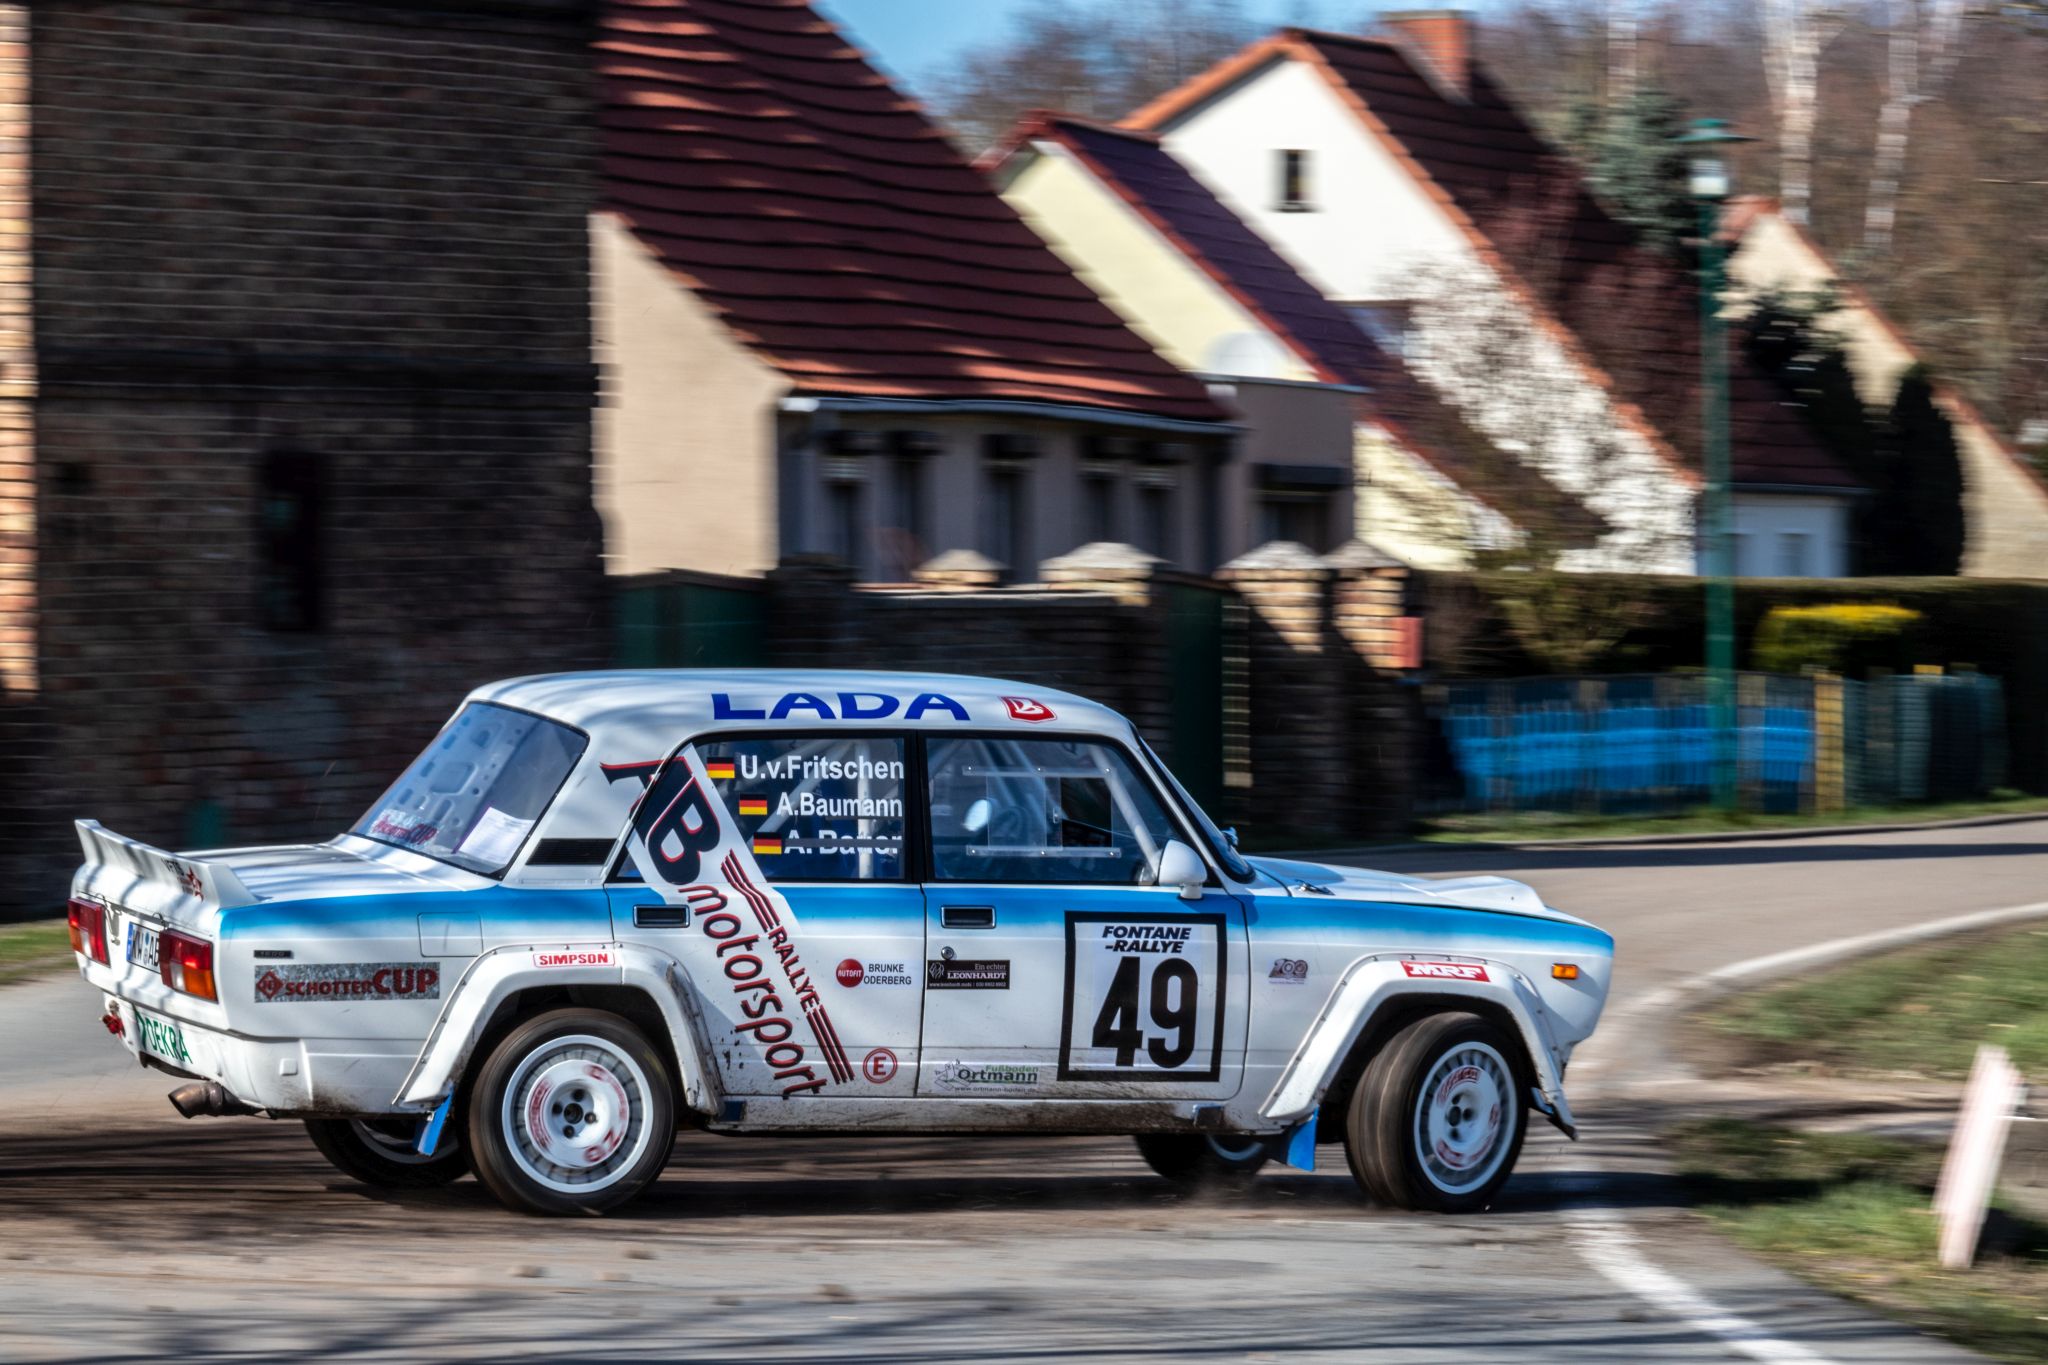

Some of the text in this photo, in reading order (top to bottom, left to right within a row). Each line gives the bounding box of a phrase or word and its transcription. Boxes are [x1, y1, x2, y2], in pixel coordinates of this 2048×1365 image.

[711, 693, 970, 721] LADA
[741, 755, 904, 779] U.v.Fritschen
[777, 792, 903, 816] A.Baumann
[1102, 925, 1192, 940] FONTANE
[1105, 939, 1184, 954] -RALLYE
[539, 953, 608, 966] SIMPSON
[767, 925, 822, 1012] RALLYE
[868, 963, 904, 973] BRUNKE
[837, 969, 862, 977] AUTOFIT
[1410, 962, 1484, 979] MRF
[863, 975, 912, 985] ODERBERG
[678, 884, 827, 1101] motorsport
[1092, 956, 1198, 1069] 49
[144, 1020, 194, 1065] DEKRA
[873, 1056, 887, 1076] E
[958, 1068, 1038, 1082] Ortmann
